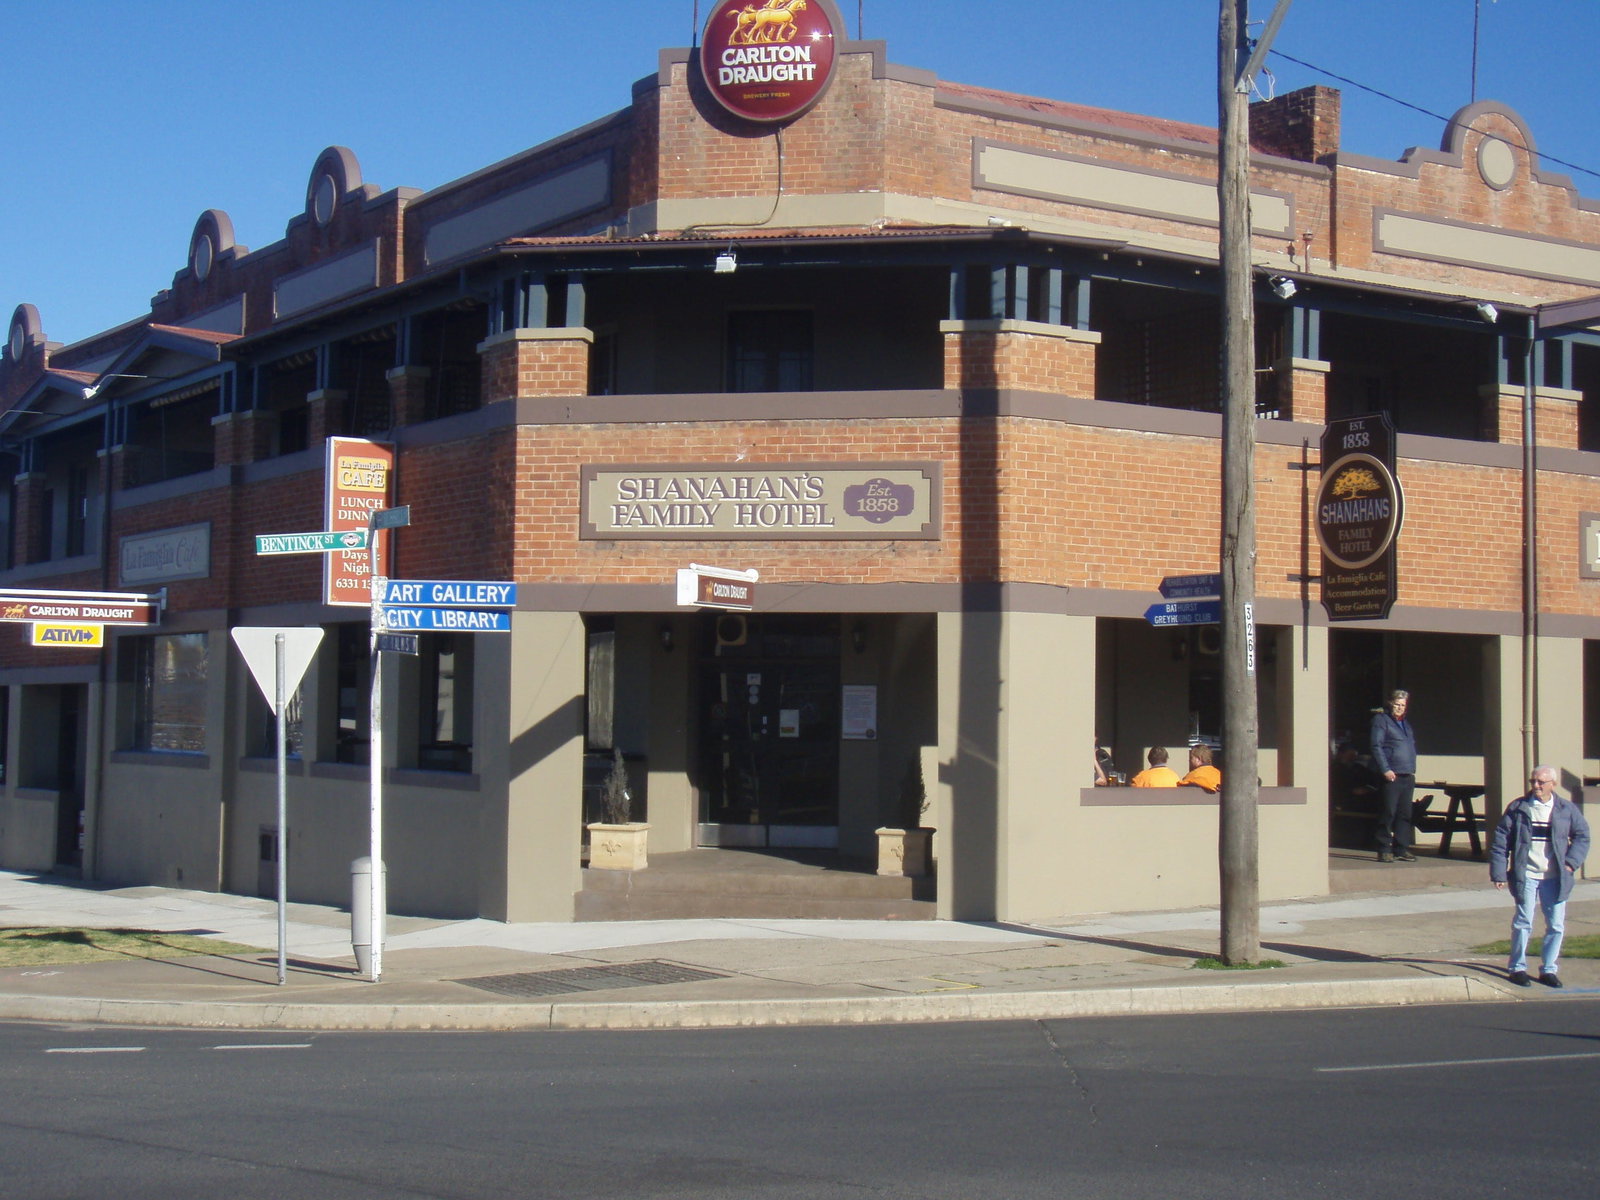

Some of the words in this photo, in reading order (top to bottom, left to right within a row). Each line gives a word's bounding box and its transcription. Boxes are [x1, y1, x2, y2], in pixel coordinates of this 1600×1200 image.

[721, 45, 811, 66] CARLTON
[719, 63, 817, 86] DRAUGHT
[1343, 431, 1370, 449] 1858
[617, 472, 825, 502] SHANAHAN'S
[866, 484, 893, 497] Est.
[340, 496, 384, 509] LUNCH
[856, 497, 898, 513] 1858
[338, 509, 369, 520] DINN
[610, 502, 721, 528] FAMILY
[733, 502, 835, 528] HOTEL
[1321, 498, 1390, 525] SHANAHANS
[1338, 527, 1374, 541] FAMILY
[260, 535, 325, 552] BENTINCK
[325, 534, 335, 544] ST
[1340, 540, 1373, 554] HOTEL
[342, 549, 368, 562] Days
[343, 562, 371, 576] Nigh
[336, 578, 359, 589] 6331
[389, 584, 423, 602] ART
[432, 584, 511, 603] GALLERY
[713, 582, 730, 598] CARLTON
[730, 584, 748, 600] DRAUGHT
[1326, 587, 1387, 599] Accommodation
[29, 605, 78, 617] CARLTON
[82, 606, 134, 619] DRAUGHT
[1165, 603, 1198, 613] BATHURST
[1334, 602, 1352, 612] Beer
[1353, 600, 1380, 610] Garden
[387, 609, 422, 628] CITY
[432, 610, 500, 629] LIBRARY
[1154, 613, 1192, 624] GREYHOUND
[1194, 613, 1211, 622] CLUB
[41, 628, 84, 642] ATM
[1246, 607, 1254, 668] 3263
